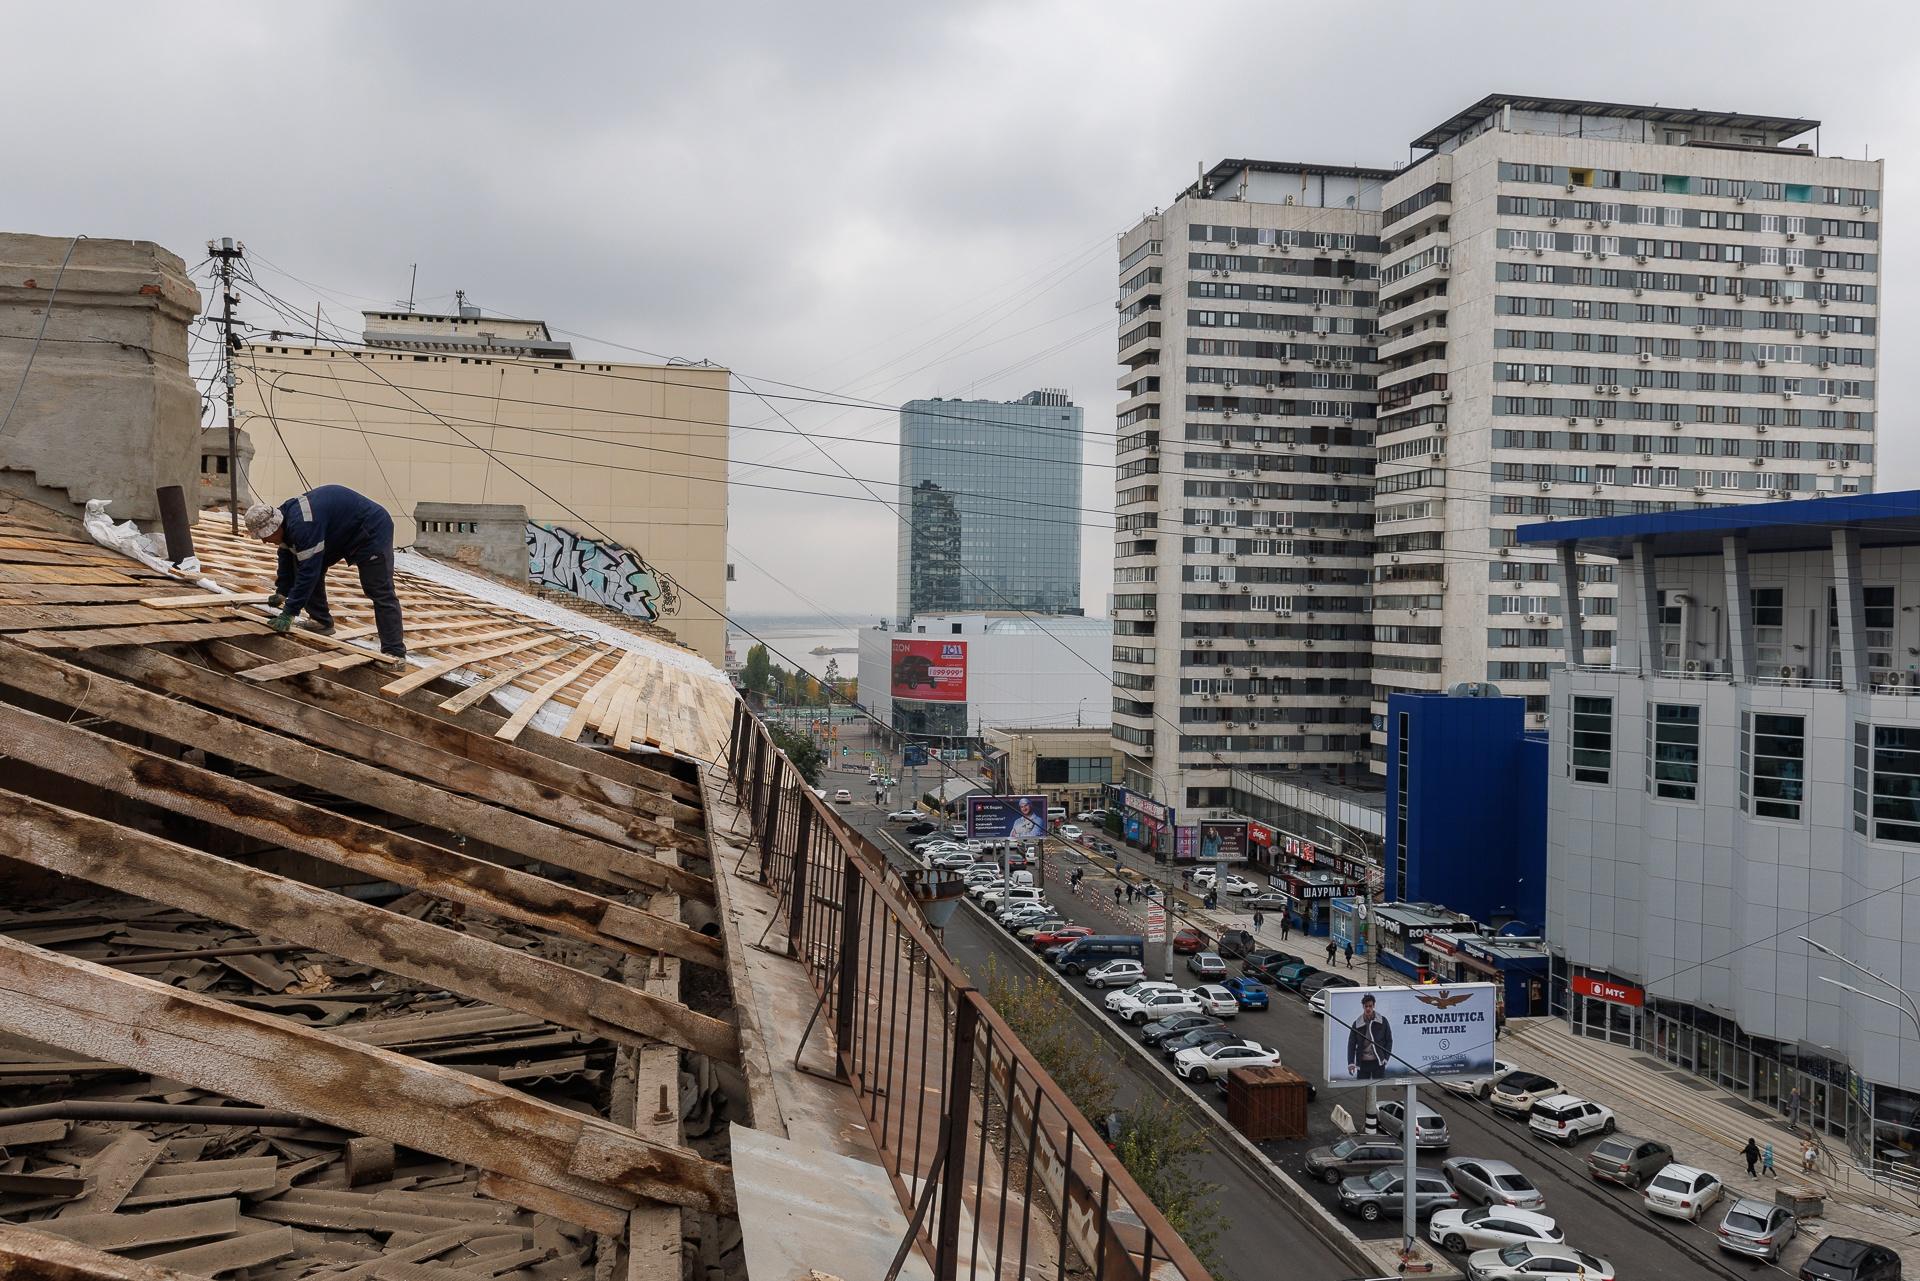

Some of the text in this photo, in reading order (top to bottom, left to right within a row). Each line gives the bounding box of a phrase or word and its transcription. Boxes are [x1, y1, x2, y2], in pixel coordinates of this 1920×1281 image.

[1303, 886, 1356, 898] ШАУРМА 33
[1605, 987, 1625, 998] МТС
[1403, 1011, 1485, 1025] AERONAUTICA
[1421, 1025, 1467, 1035] MILITARE
